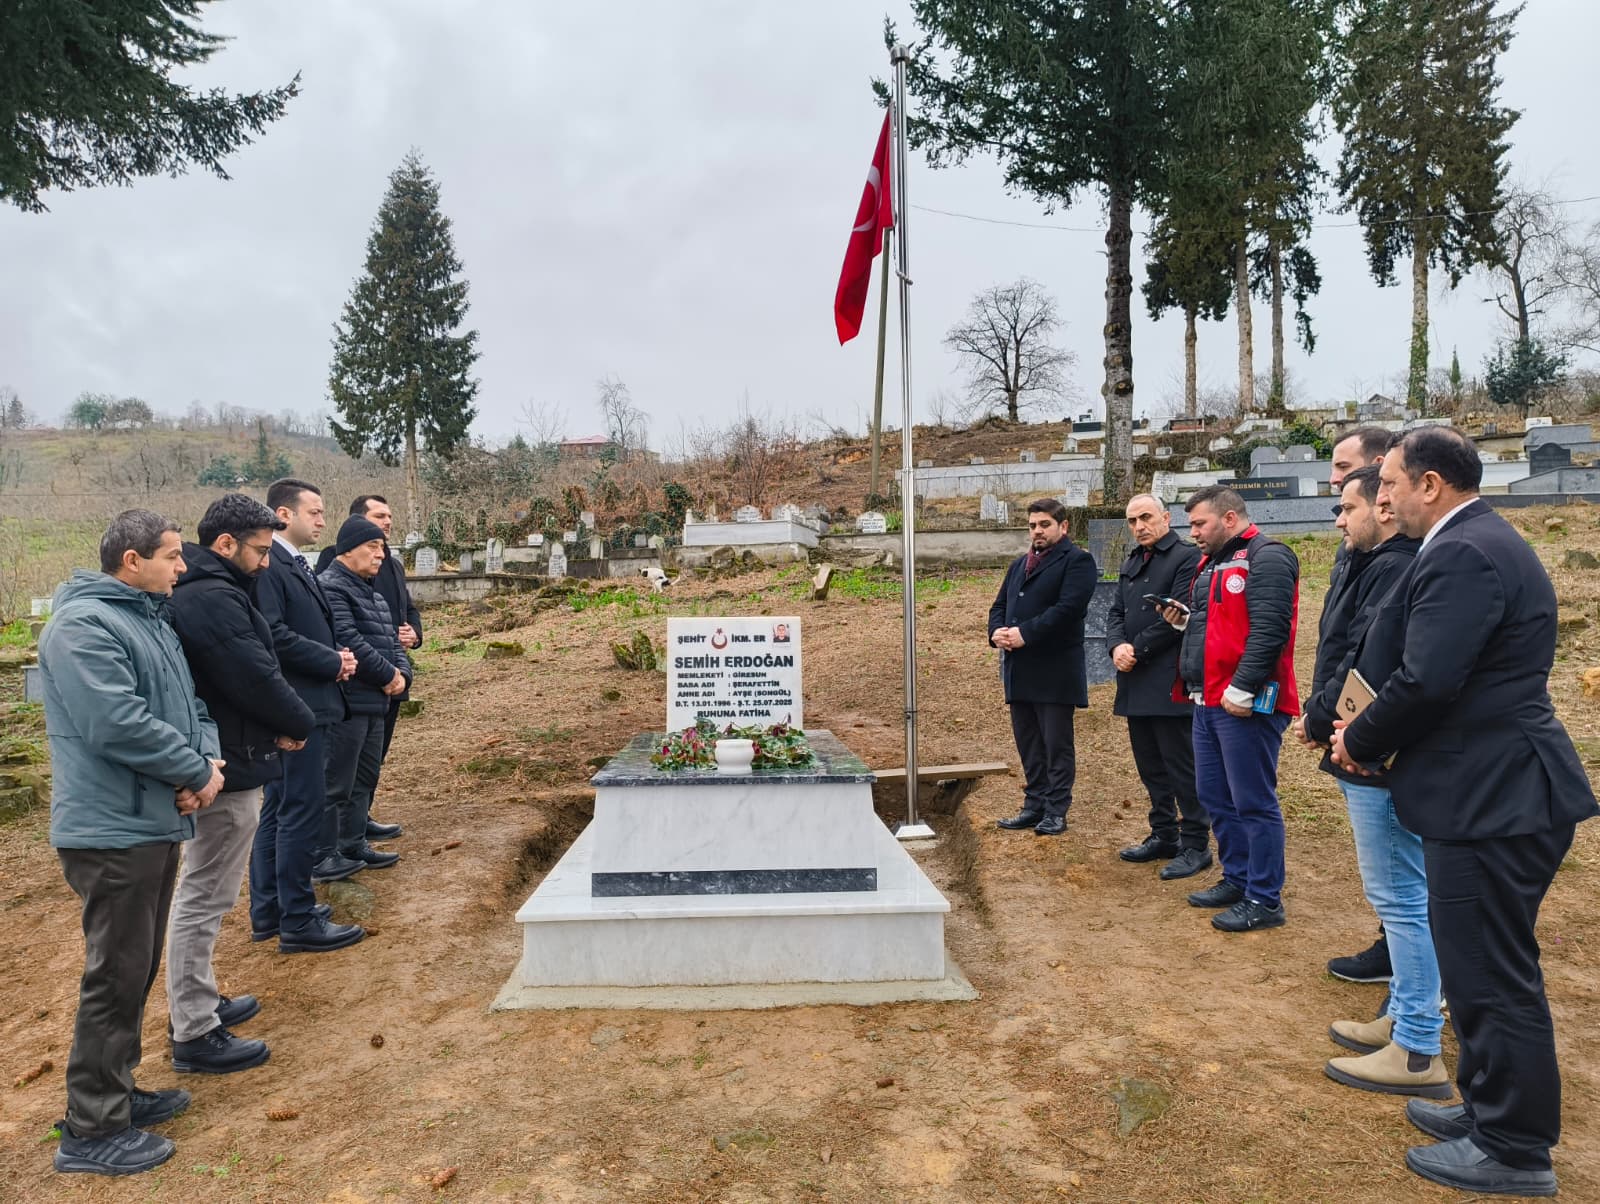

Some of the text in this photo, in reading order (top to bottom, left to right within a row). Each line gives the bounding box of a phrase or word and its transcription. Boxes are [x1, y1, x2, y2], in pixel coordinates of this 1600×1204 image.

[677, 634, 765, 645] ŞEHİT İKM. ER
[674, 653, 794, 669] SEMİH ERDOĞAN
[677, 671, 724, 679] MEMLEKETİ
[732, 680, 780, 689] ŞERAFETTİN
[732, 690, 753, 698] AYŞE
[754, 689, 791, 698] (SONGÜL)
[697, 709, 771, 718] RUHUNA FATİHA
